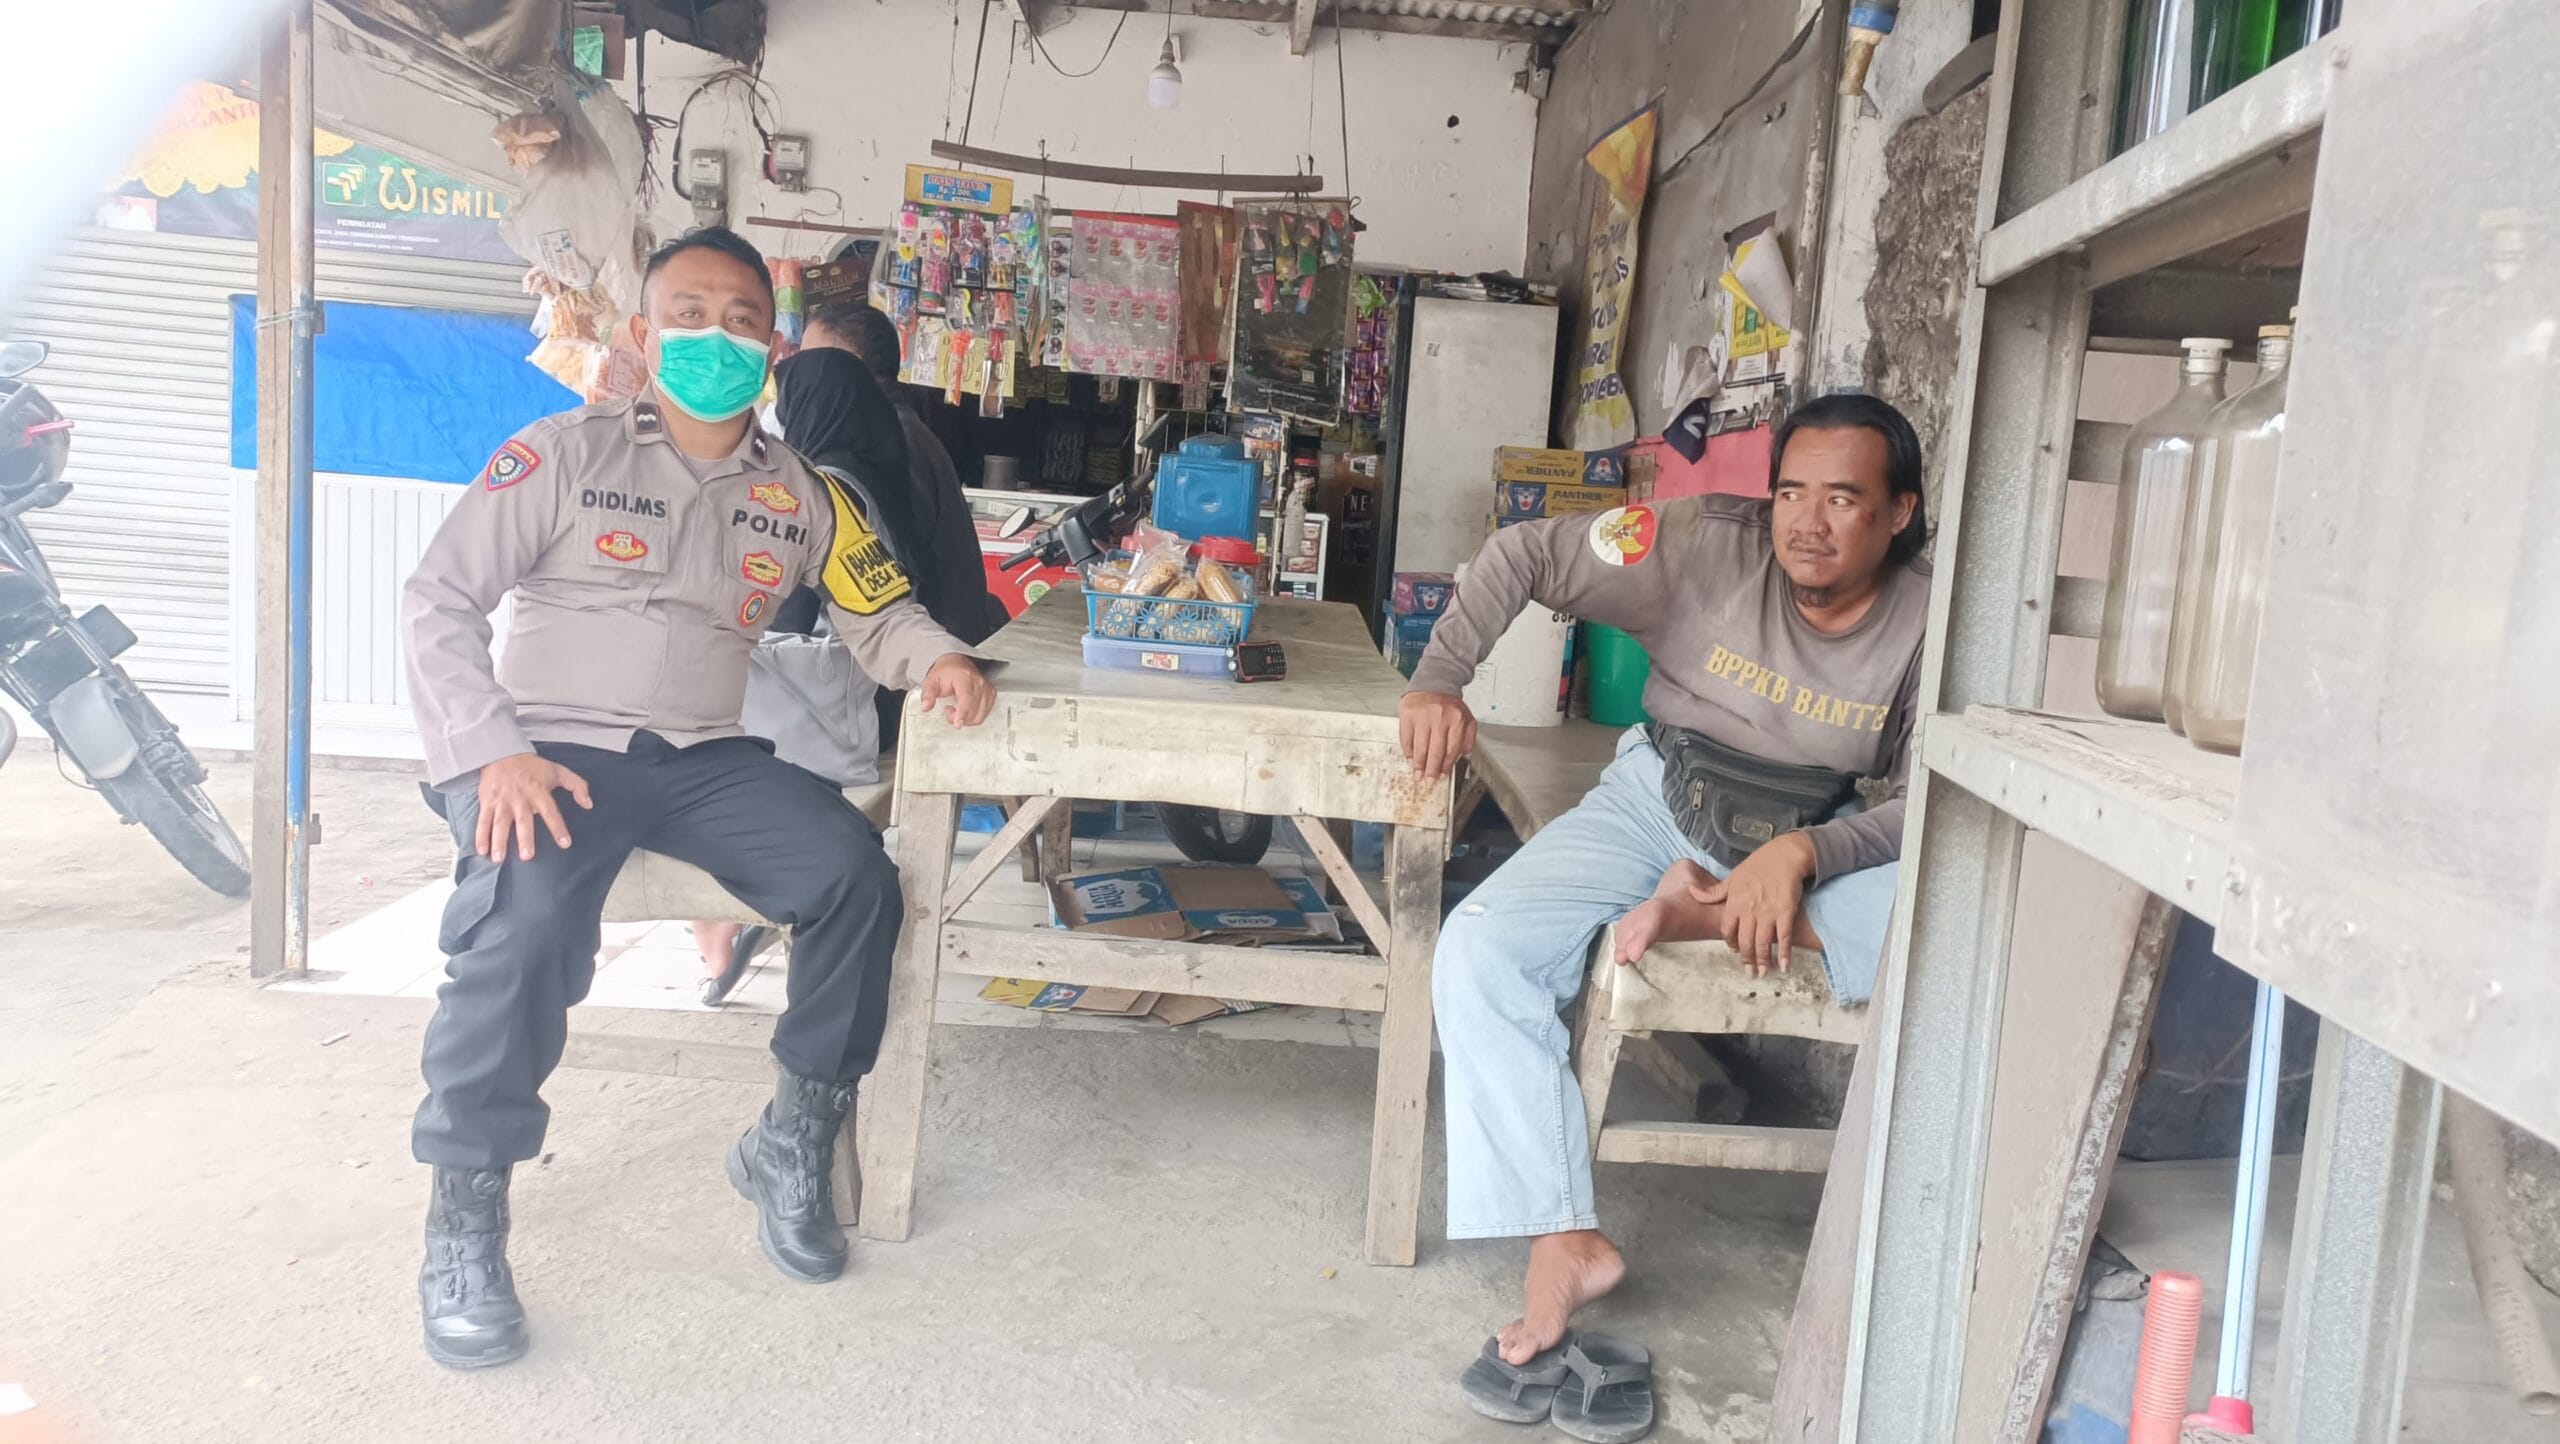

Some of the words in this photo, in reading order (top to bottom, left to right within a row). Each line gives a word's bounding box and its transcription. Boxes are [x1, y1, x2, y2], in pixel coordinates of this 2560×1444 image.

[379, 165, 502, 220] WISMIL
[1526, 465, 1577, 478] PANTHER
[580, 488, 667, 519] DIDI.MS
[1552, 489, 1603, 501] PANTHER
[731, 507, 808, 546] POLRI
[865, 567, 896, 593] DESA
[1704, 643, 1790, 704] BPPKB
[1791, 685, 1890, 732] BANTE
[1227, 915, 1270, 925] AQUA
